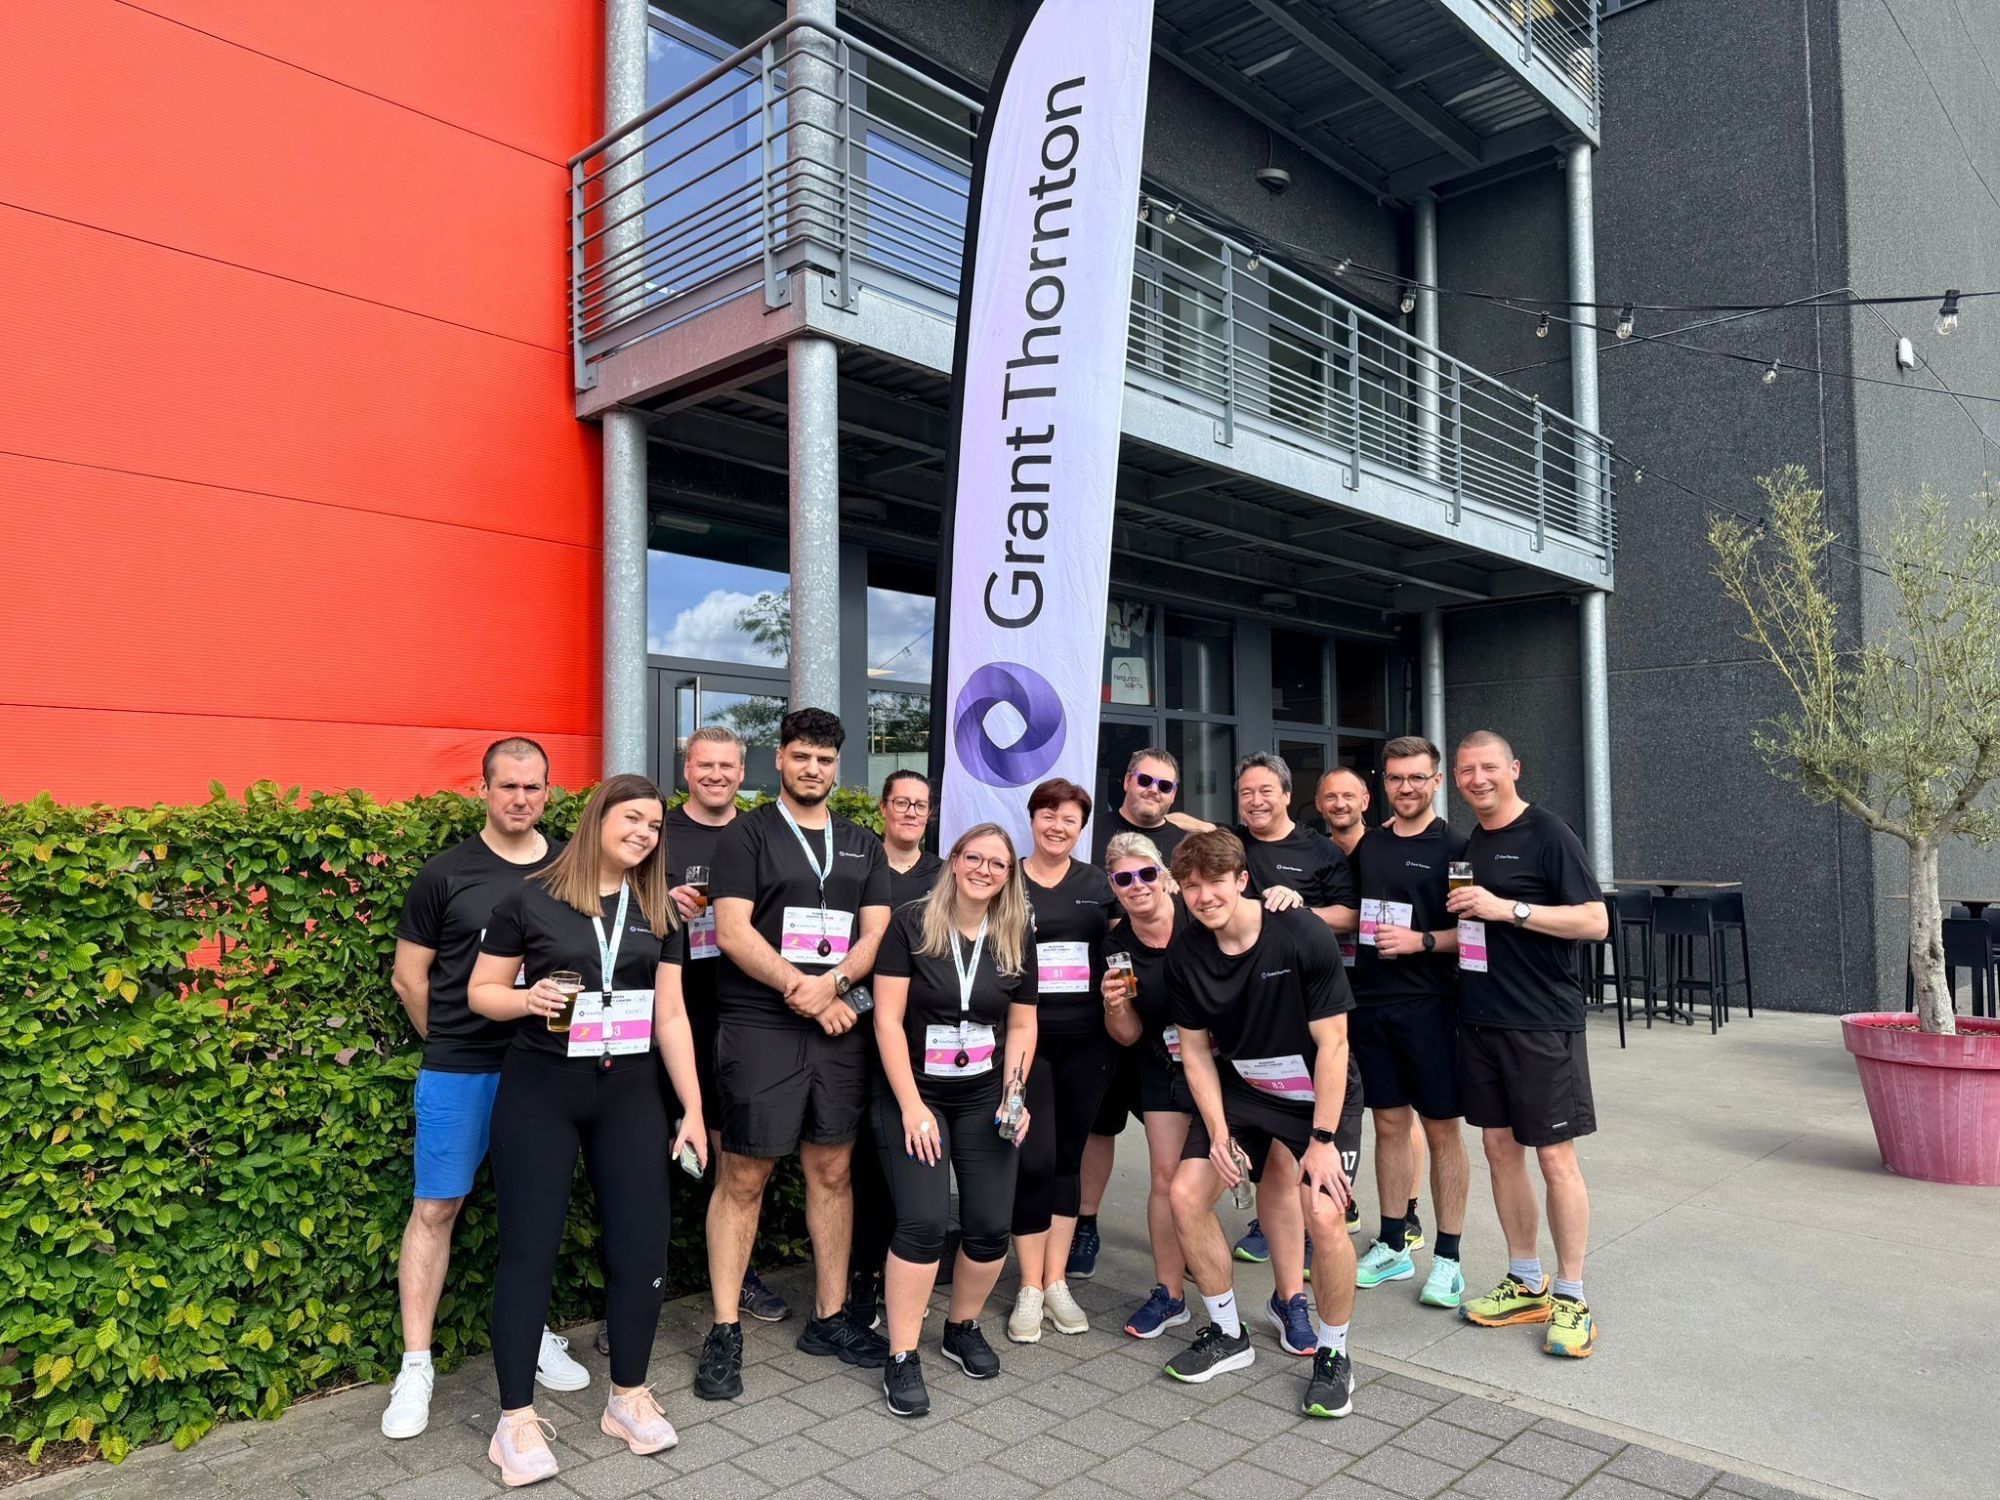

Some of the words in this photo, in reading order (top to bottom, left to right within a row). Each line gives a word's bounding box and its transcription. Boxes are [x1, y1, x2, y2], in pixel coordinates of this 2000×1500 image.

[1001, 76, 1086, 421] Thornton
[983, 424, 1055, 629] Grant
[1341, 1151, 1357, 1171] 17
